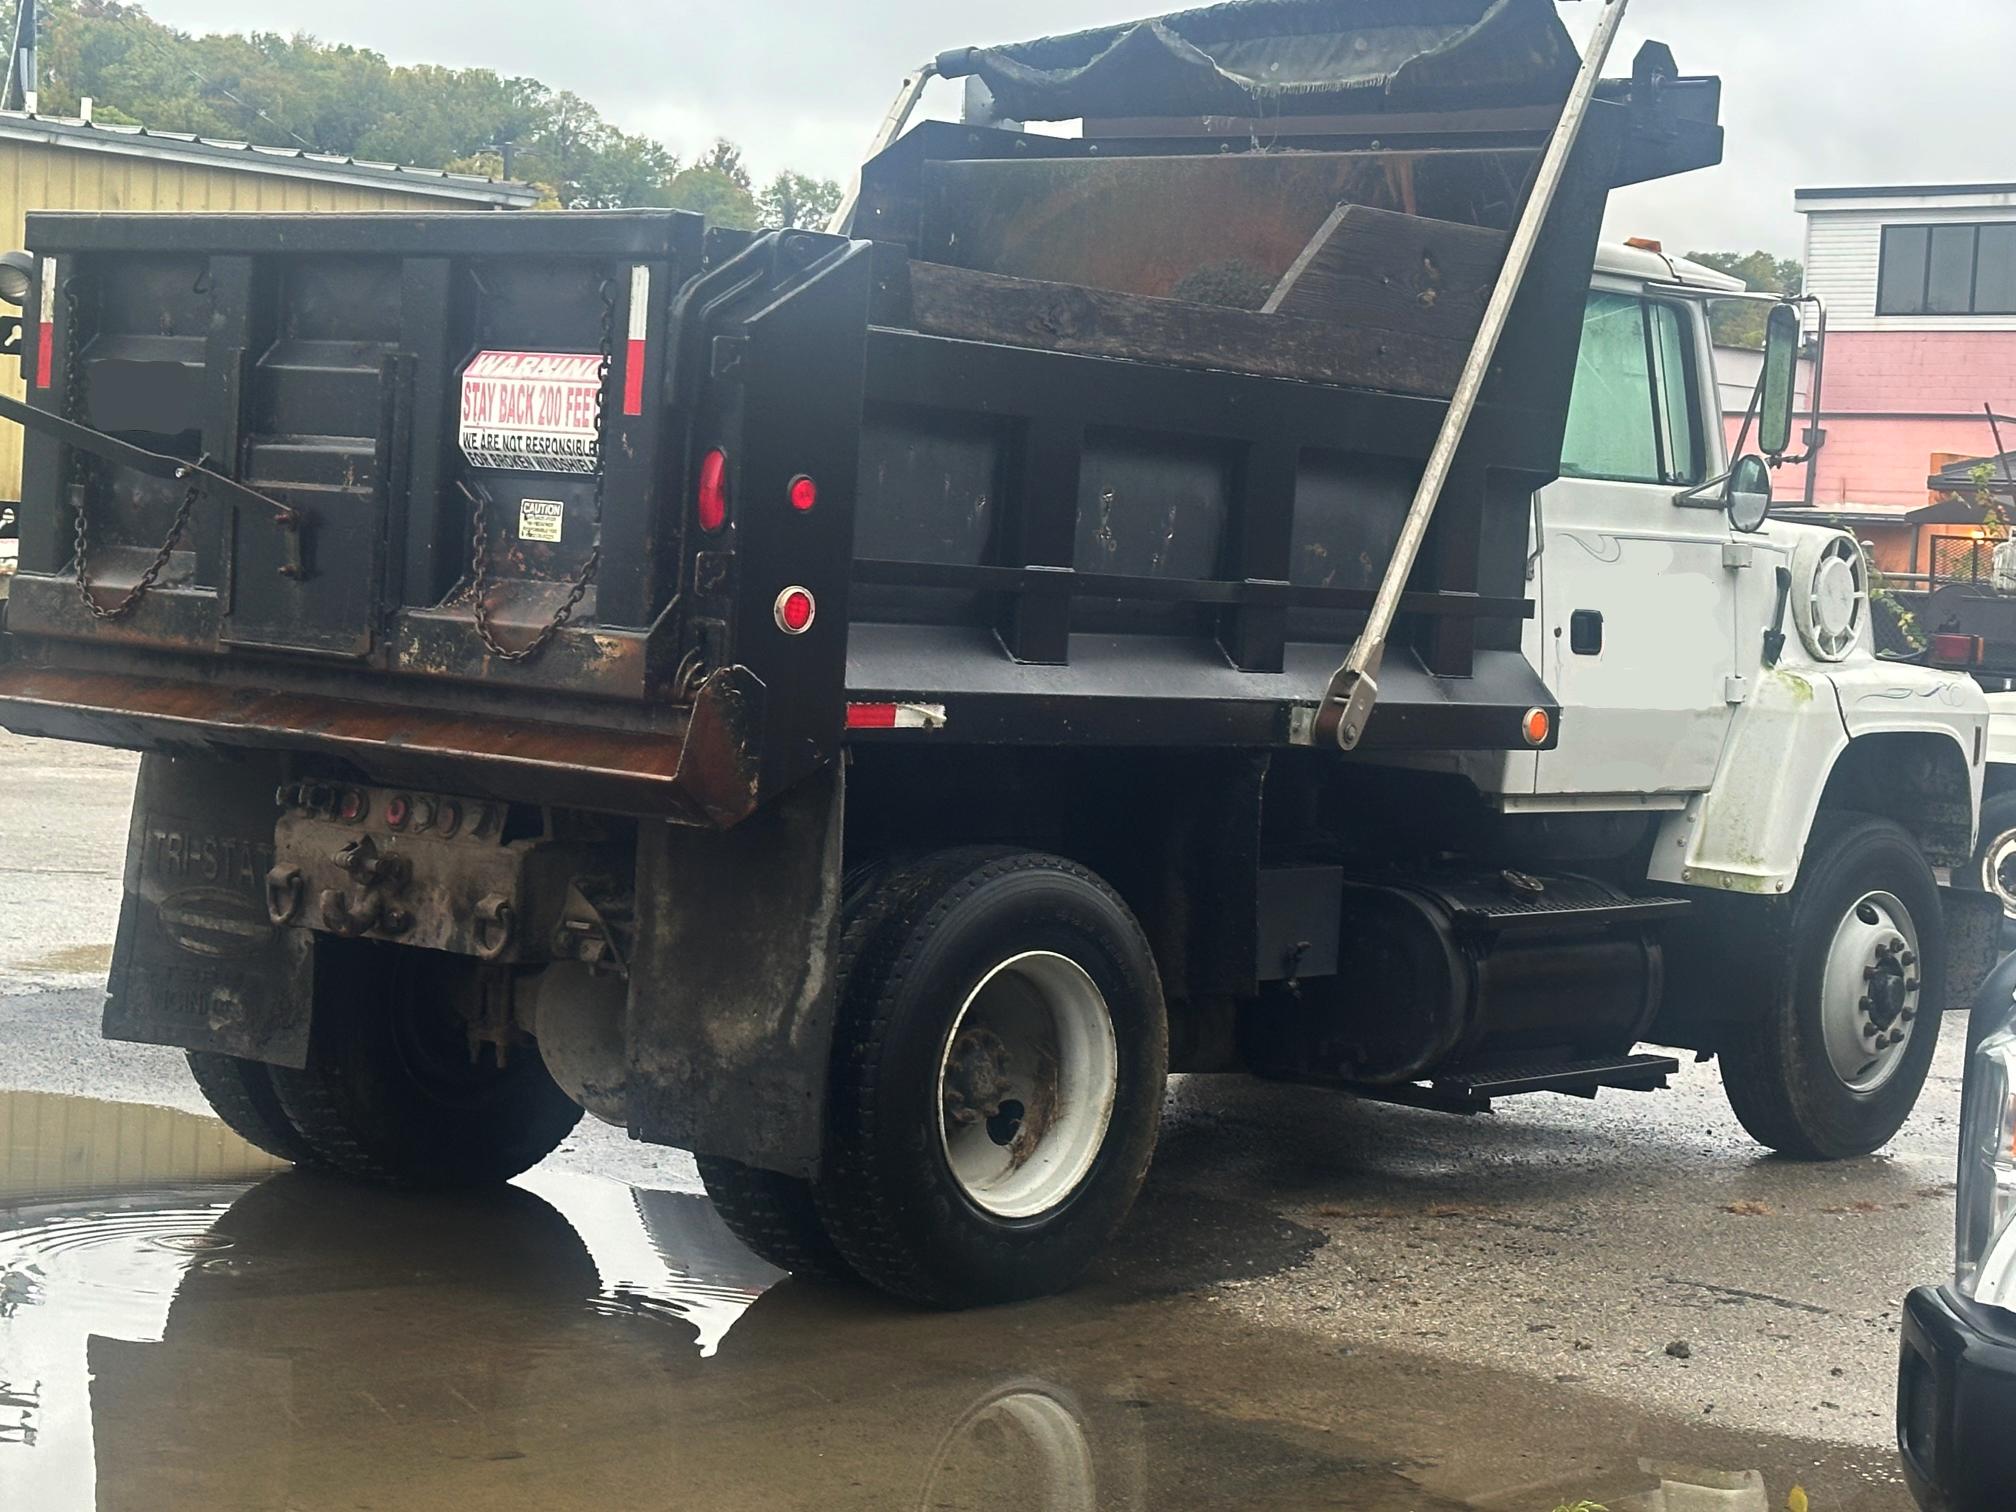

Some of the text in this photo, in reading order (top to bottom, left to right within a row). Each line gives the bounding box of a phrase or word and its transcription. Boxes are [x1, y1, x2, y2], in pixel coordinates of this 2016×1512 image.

[463, 381, 597, 428] STAY BACK 200 FEET
[463, 432, 596, 457] WE ARE NOT RESPONSIBLE
[467, 451, 490, 467] FOR
[487, 453, 533, 470] BROKEN
[523, 502, 561, 515] CAUTION
[153, 829, 276, 888] TRI-STAT
